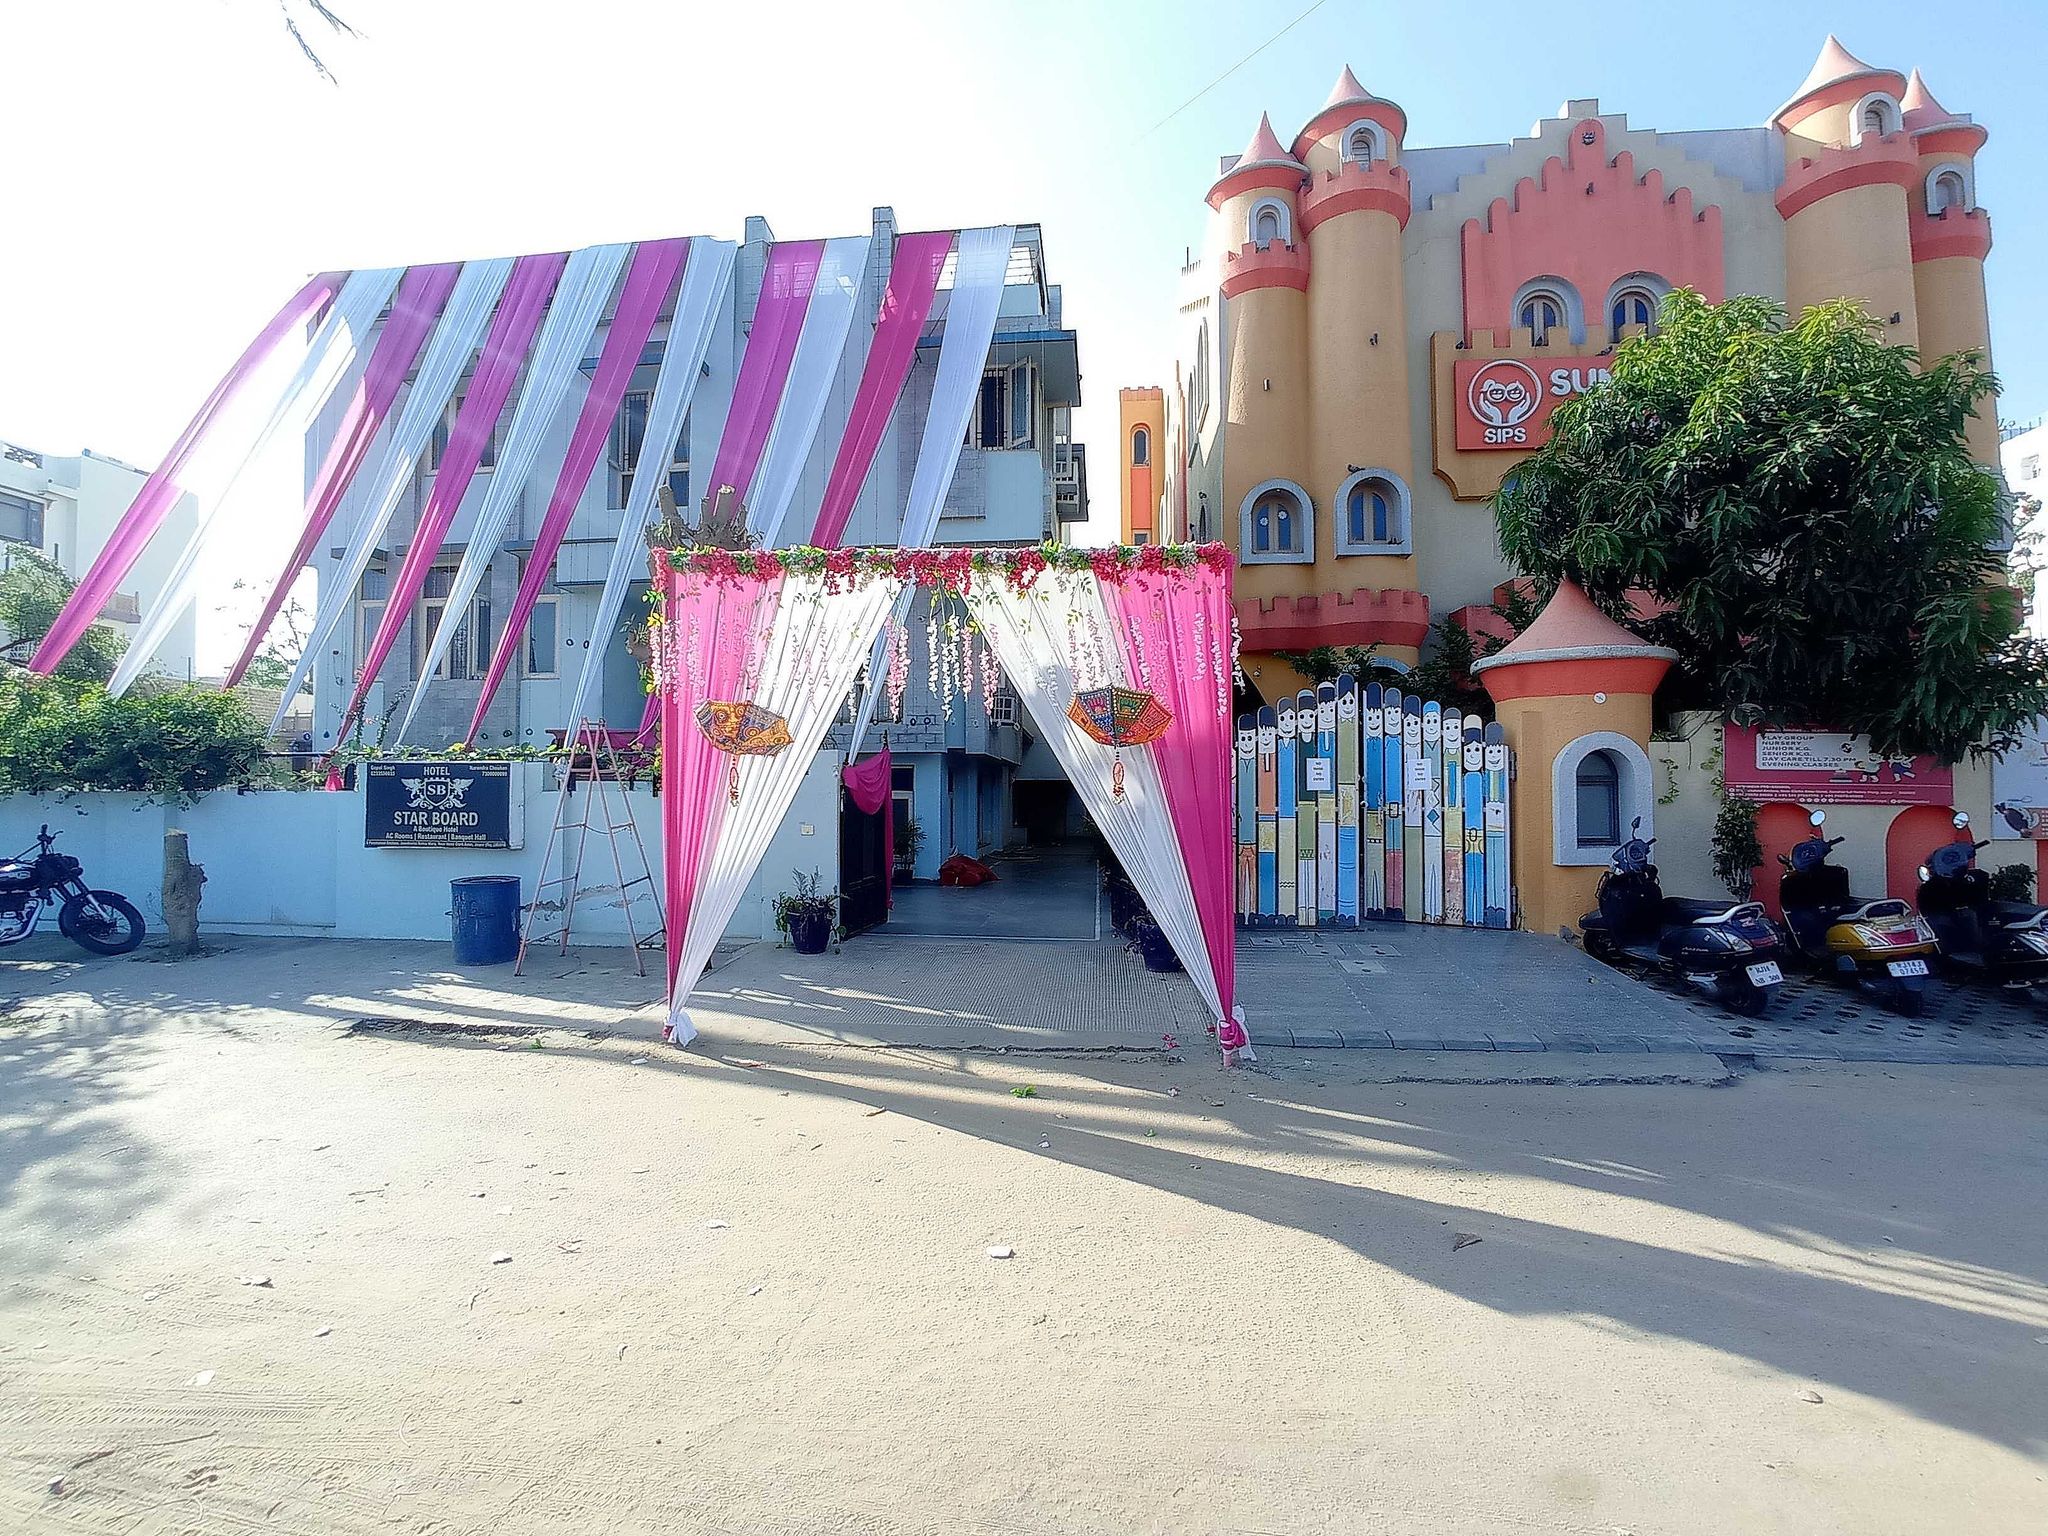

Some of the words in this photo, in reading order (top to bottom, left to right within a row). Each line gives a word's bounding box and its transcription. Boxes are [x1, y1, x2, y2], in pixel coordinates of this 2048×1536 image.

[1483, 427, 1527, 443] SIPS
[423, 767, 450, 776] HOTEL
[427, 786, 447, 796] SB
[394, 811, 428, 826] STAR
[432, 812, 478, 826] BOARD
